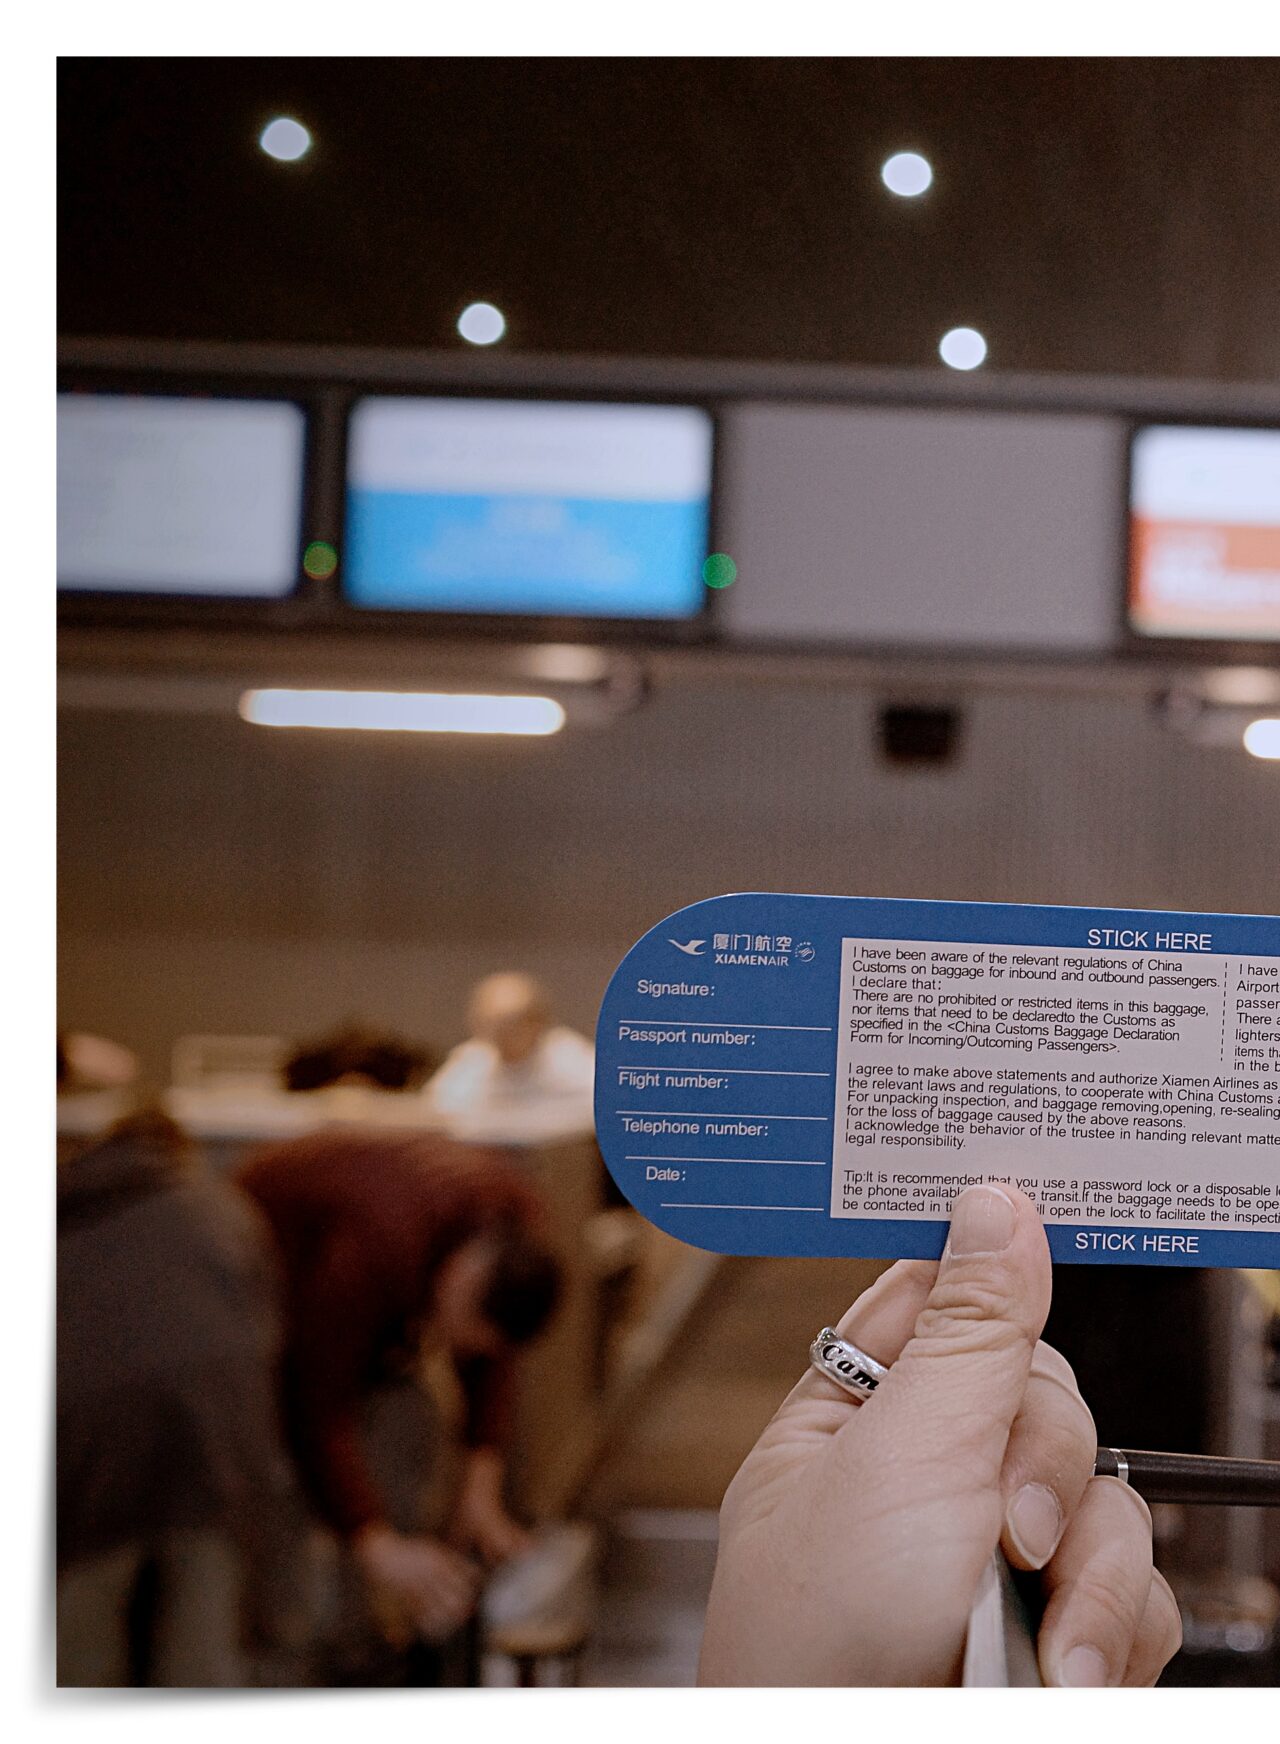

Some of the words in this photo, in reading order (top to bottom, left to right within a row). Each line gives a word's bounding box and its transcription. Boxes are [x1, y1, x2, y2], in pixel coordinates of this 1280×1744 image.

[712, 933, 792, 953] 厦门航空
[1087, 929, 1148, 948] STICK
[1155, 932, 1212, 950] HERE
[714, 953, 789, 967] XIAMENAIR
[852, 945, 857, 958] I
[860, 945, 891, 960] have
[895, 947, 926, 961] been
[930, 951, 969, 963] aware
[972, 951, 985, 963] of
[988, 951, 1008, 965] the
[1011, 952, 1059, 967] relevant
[1062, 955, 1128, 971] regulations
[1131, 957, 1144, 970] of
[1147, 958, 1183, 972] China
[851, 959, 907, 974] Customs
[910, 964, 927, 975] on
[930, 963, 985, 980] baggage
[988, 965, 1005, 978] for
[1008, 966, 1057, 980] inbound
[1060, 968, 1084, 982] and
[1087, 970, 1144, 984] outbound
[1148, 975, 1220, 989] passengers.
[1239, 963, 1243, 975] I
[1246, 963, 1278, 977] have
[637, 979, 715, 998] Signature:
[851, 974, 855, 987] I
[858, 975, 908, 989] declare
[911, 977, 942, 991] that:
[1235, 979, 1280, 995] Airport
[852, 987, 889, 1002] There
[892, 992, 913, 1003] are
[917, 993, 934, 1004] no
[937, 992, 997, 1009] prohibited
[1000, 997, 1014, 1007] or
[1017, 996, 1072, 1010] restricted
[1076, 997, 1109, 1011] items
[1113, 999, 1124, 1012] in
[1127, 1000, 1149, 1013] this
[1152, 1000, 1209, 1018] baggage,
[851, 1004, 873, 1015] nor
[876, 1003, 910, 1017] items
[913, 1005, 937, 1018] that
[940, 1006, 972, 1019] need
[975, 1007, 988, 1020] to
[991, 1007, 1008, 1021] be
[1011, 1008, 1075, 1024] declaredto
[1079, 1011, 1099, 1024] the
[1102, 1012, 1157, 1027] Customs
[1160, 1017, 1176, 1028] as
[1238, 1011, 1272, 1025] There
[618, 1026, 686, 1045] Passport
[691, 1031, 756, 1045] number:
[849, 1017, 904, 1033] specified
[907, 1018, 919, 1031] in
[922, 1018, 943, 1032] the
[946, 1020, 991, 1034] <China
[994, 1021, 1049, 1036] Customs
[1053, 1024, 1109, 1041] Baggage
[1112, 1026, 1180, 1041] Declaration
[850, 1029, 883, 1044] Form
[886, 1031, 904, 1044] for
[908, 1032, 1033, 1052] Incoming/Outcoming
[1037, 1037, 1120, 1055] Passengers>.
[1234, 1044, 1265, 1058] items
[1233, 1058, 1245, 1071] in
[1249, 1059, 1270, 1072] the
[618, 1071, 660, 1089] Flight
[665, 1074, 729, 1089] number:
[846, 1103, 864, 1116] for
[867, 1104, 888, 1118] the
[891, 1105, 917, 1119] loss
[920, 1106, 934, 1119] of
[937, 1106, 993, 1124] baggage
[996, 1110, 1043, 1123] caused
[1047, 1111, 1063, 1127] by
[1066, 1112, 1086, 1125] the
[1089, 1112, 1129, 1126] above
[1132, 1116, 1186, 1128] reasons.
[621, 1118, 700, 1136] Telephone
[705, 1121, 769, 1137] number:
[845, 1117, 849, 1130] I
[853, 1118, 940, 1136] acknowledge
[944, 1121, 965, 1134] the
[969, 1122, 1025, 1136] behavior
[1029, 1124, 1043, 1137] of
[1046, 1124, 1067, 1138] the
[1070, 1126, 1115, 1139] trustee
[1119, 1127, 1131, 1140] in
[1135, 1128, 1187, 1145] handing
[1191, 1130, 1242, 1144] relevant
[844, 1131, 876, 1147] legal
[880, 1133, 966, 1150] responsibility.
[646, 1166, 686, 1181] Date:
[841, 1197, 859, 1210] be
[862, 1199, 925, 1212] contacted
[929, 1199, 941, 1212] in
[1049, 1206, 1081, 1219] open
[1085, 1205, 1105, 1218] the
[1109, 1205, 1135, 1219] lock
[1139, 1207, 1152, 1219] to
[1155, 1207, 1206, 1221] facilitate
[1210, 1209, 1230, 1222] the
[1075, 1232, 1137, 1251] STICK
[1142, 1235, 1200, 1253] HERE
